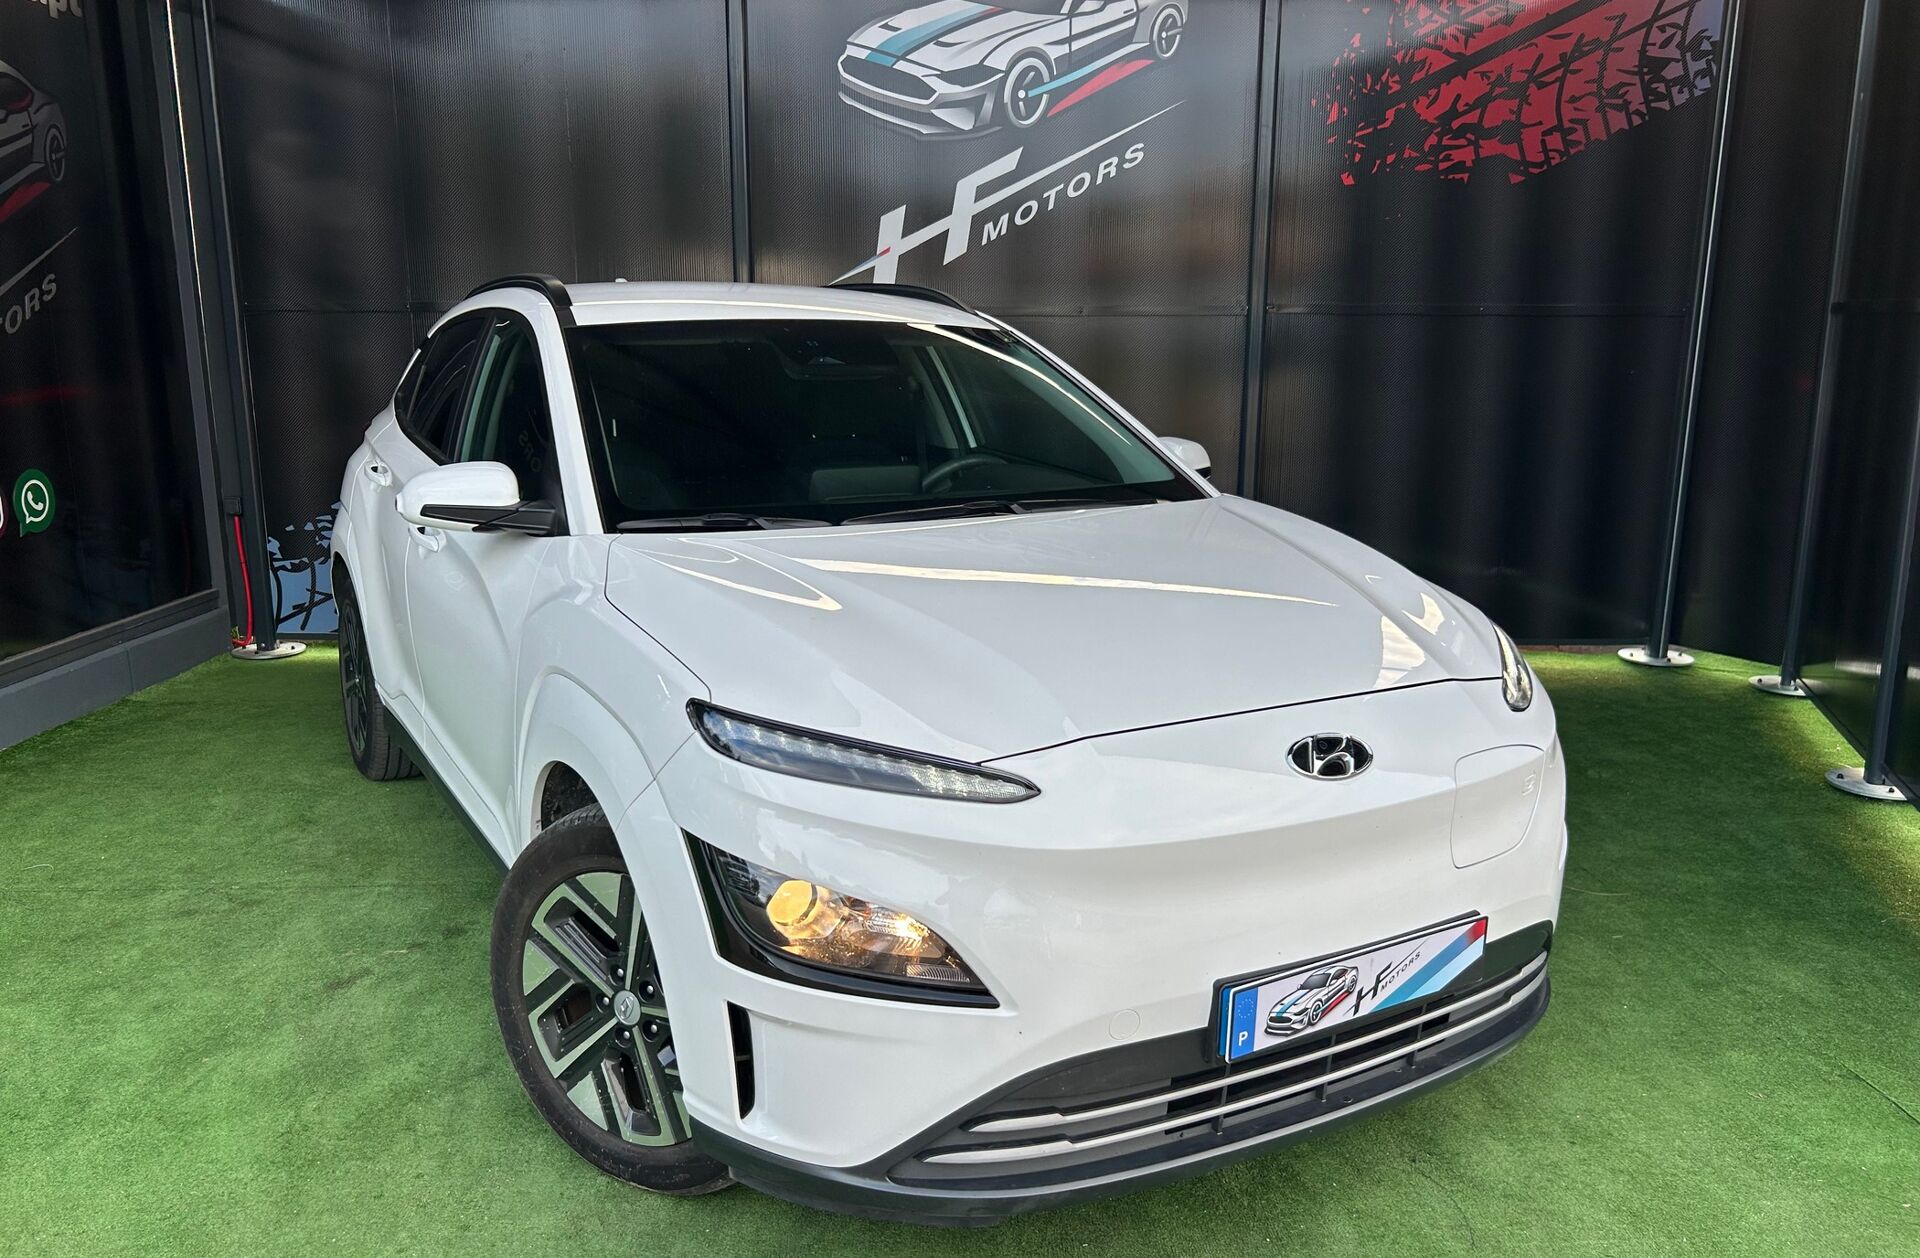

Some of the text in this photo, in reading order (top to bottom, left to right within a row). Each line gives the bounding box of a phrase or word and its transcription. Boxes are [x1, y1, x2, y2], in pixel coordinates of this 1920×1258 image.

[981, 142, 1146, 246] MOTORS
[0, 273, 57, 334] ORS
[1380, 951, 1421, 992] MOTORS
[1238, 1030, 1249, 1047] P
